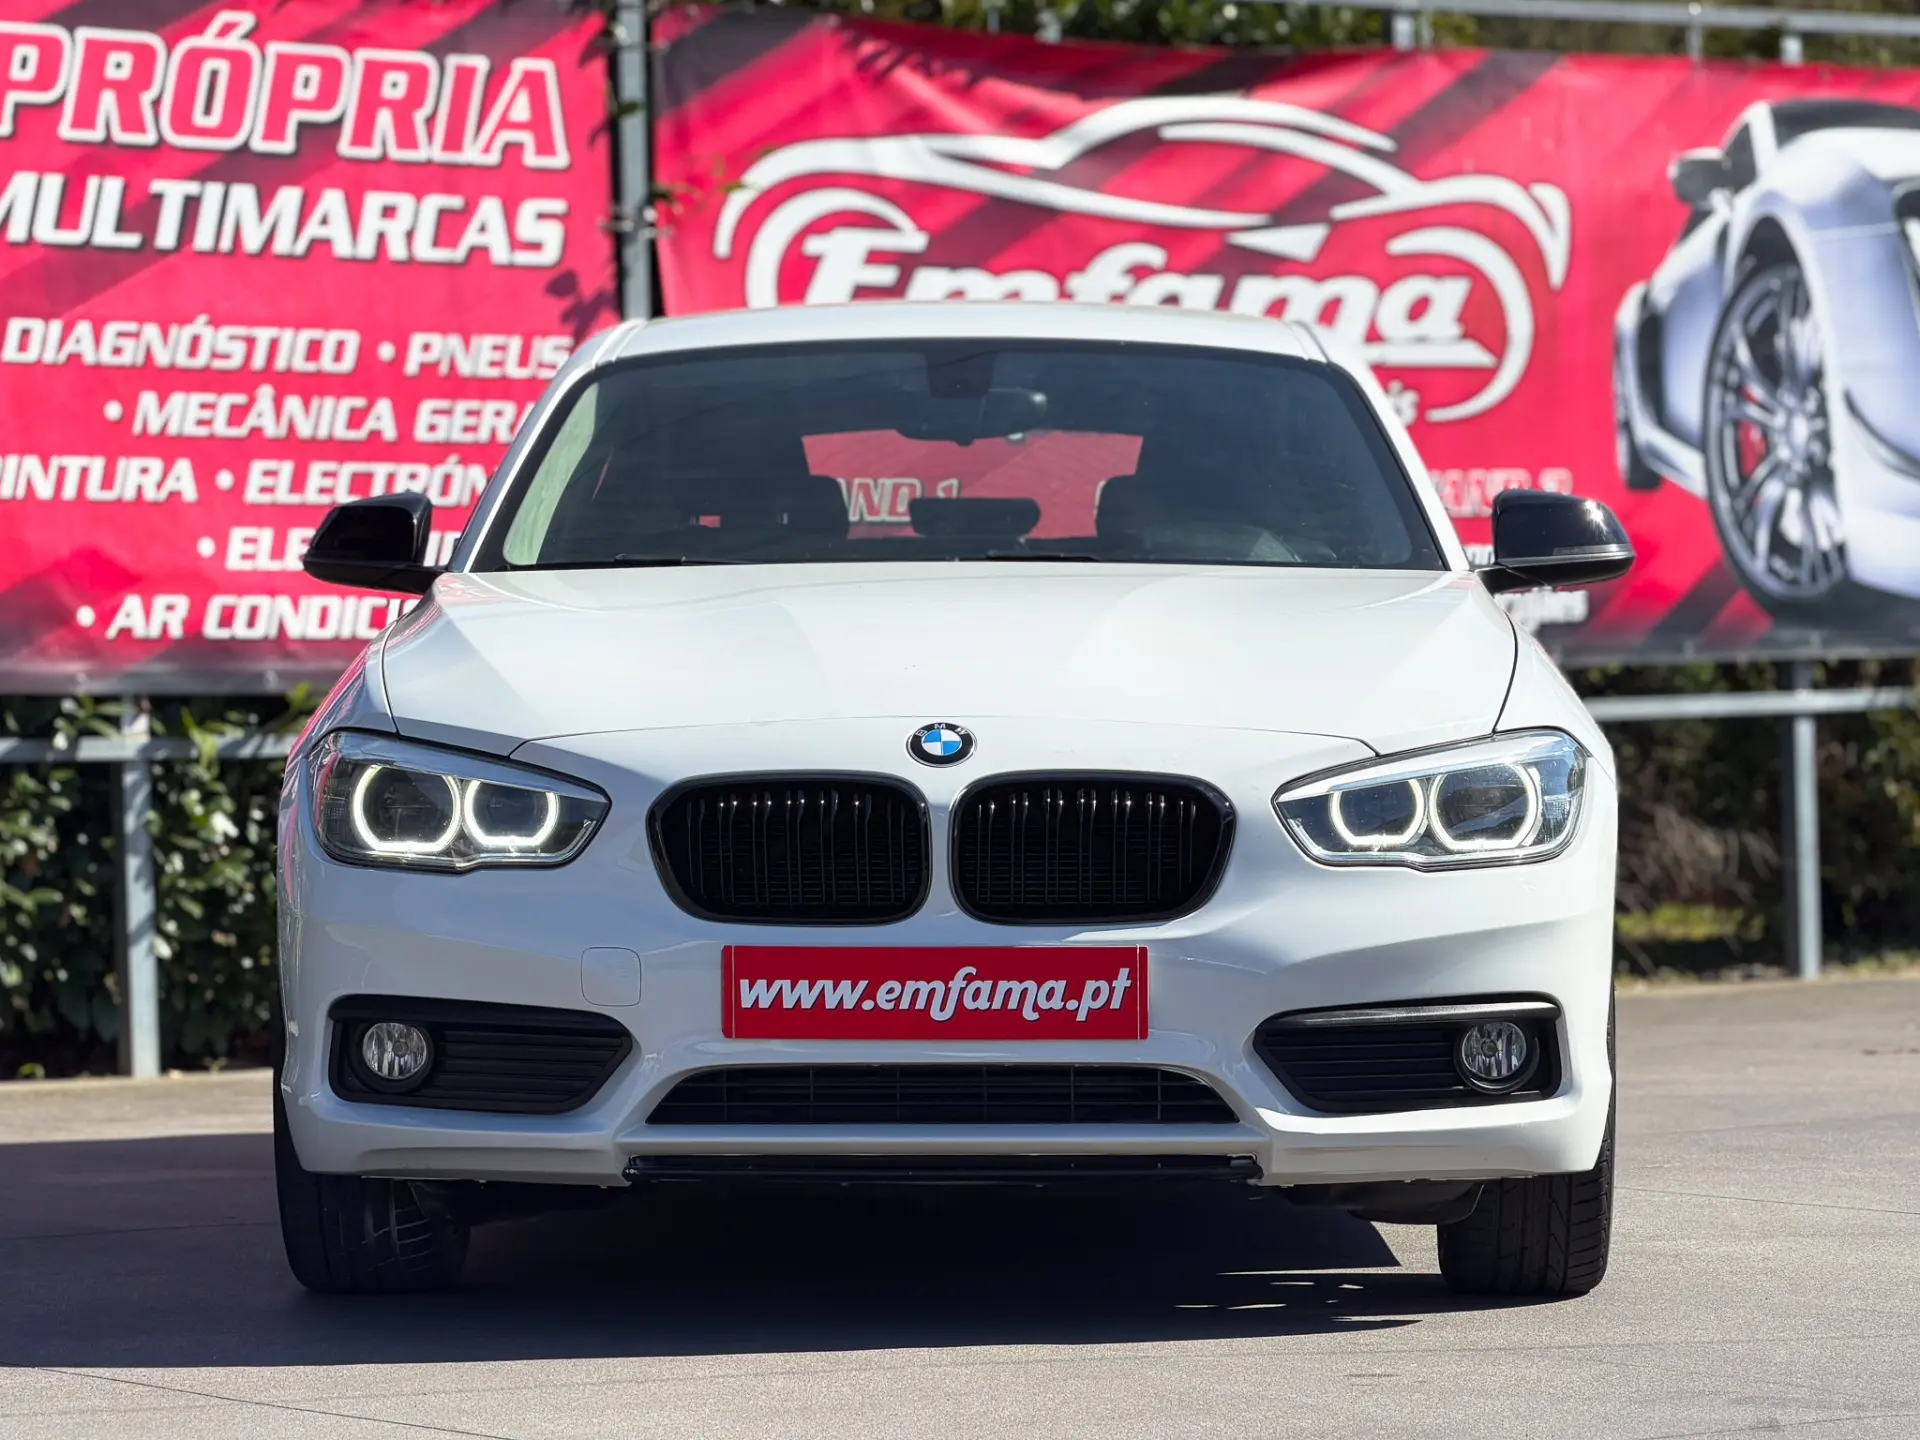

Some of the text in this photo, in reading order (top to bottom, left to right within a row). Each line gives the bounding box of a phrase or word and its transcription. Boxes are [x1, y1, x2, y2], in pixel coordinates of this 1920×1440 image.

[0, 10, 571, 169] PRÓPRIA
[0, 171, 569, 267] MULTIMARCAS
[3, 315, 573, 380] DIAGNÓSTICO PNEUS
[132, 384, 537, 444] MECÂNICA GER
[0, 453, 198, 502] INTURA
[106, 594, 189, 640] AR
[914, 723, 970, 737] BMW
[739, 966, 1132, 1022] www.emfama.pt
